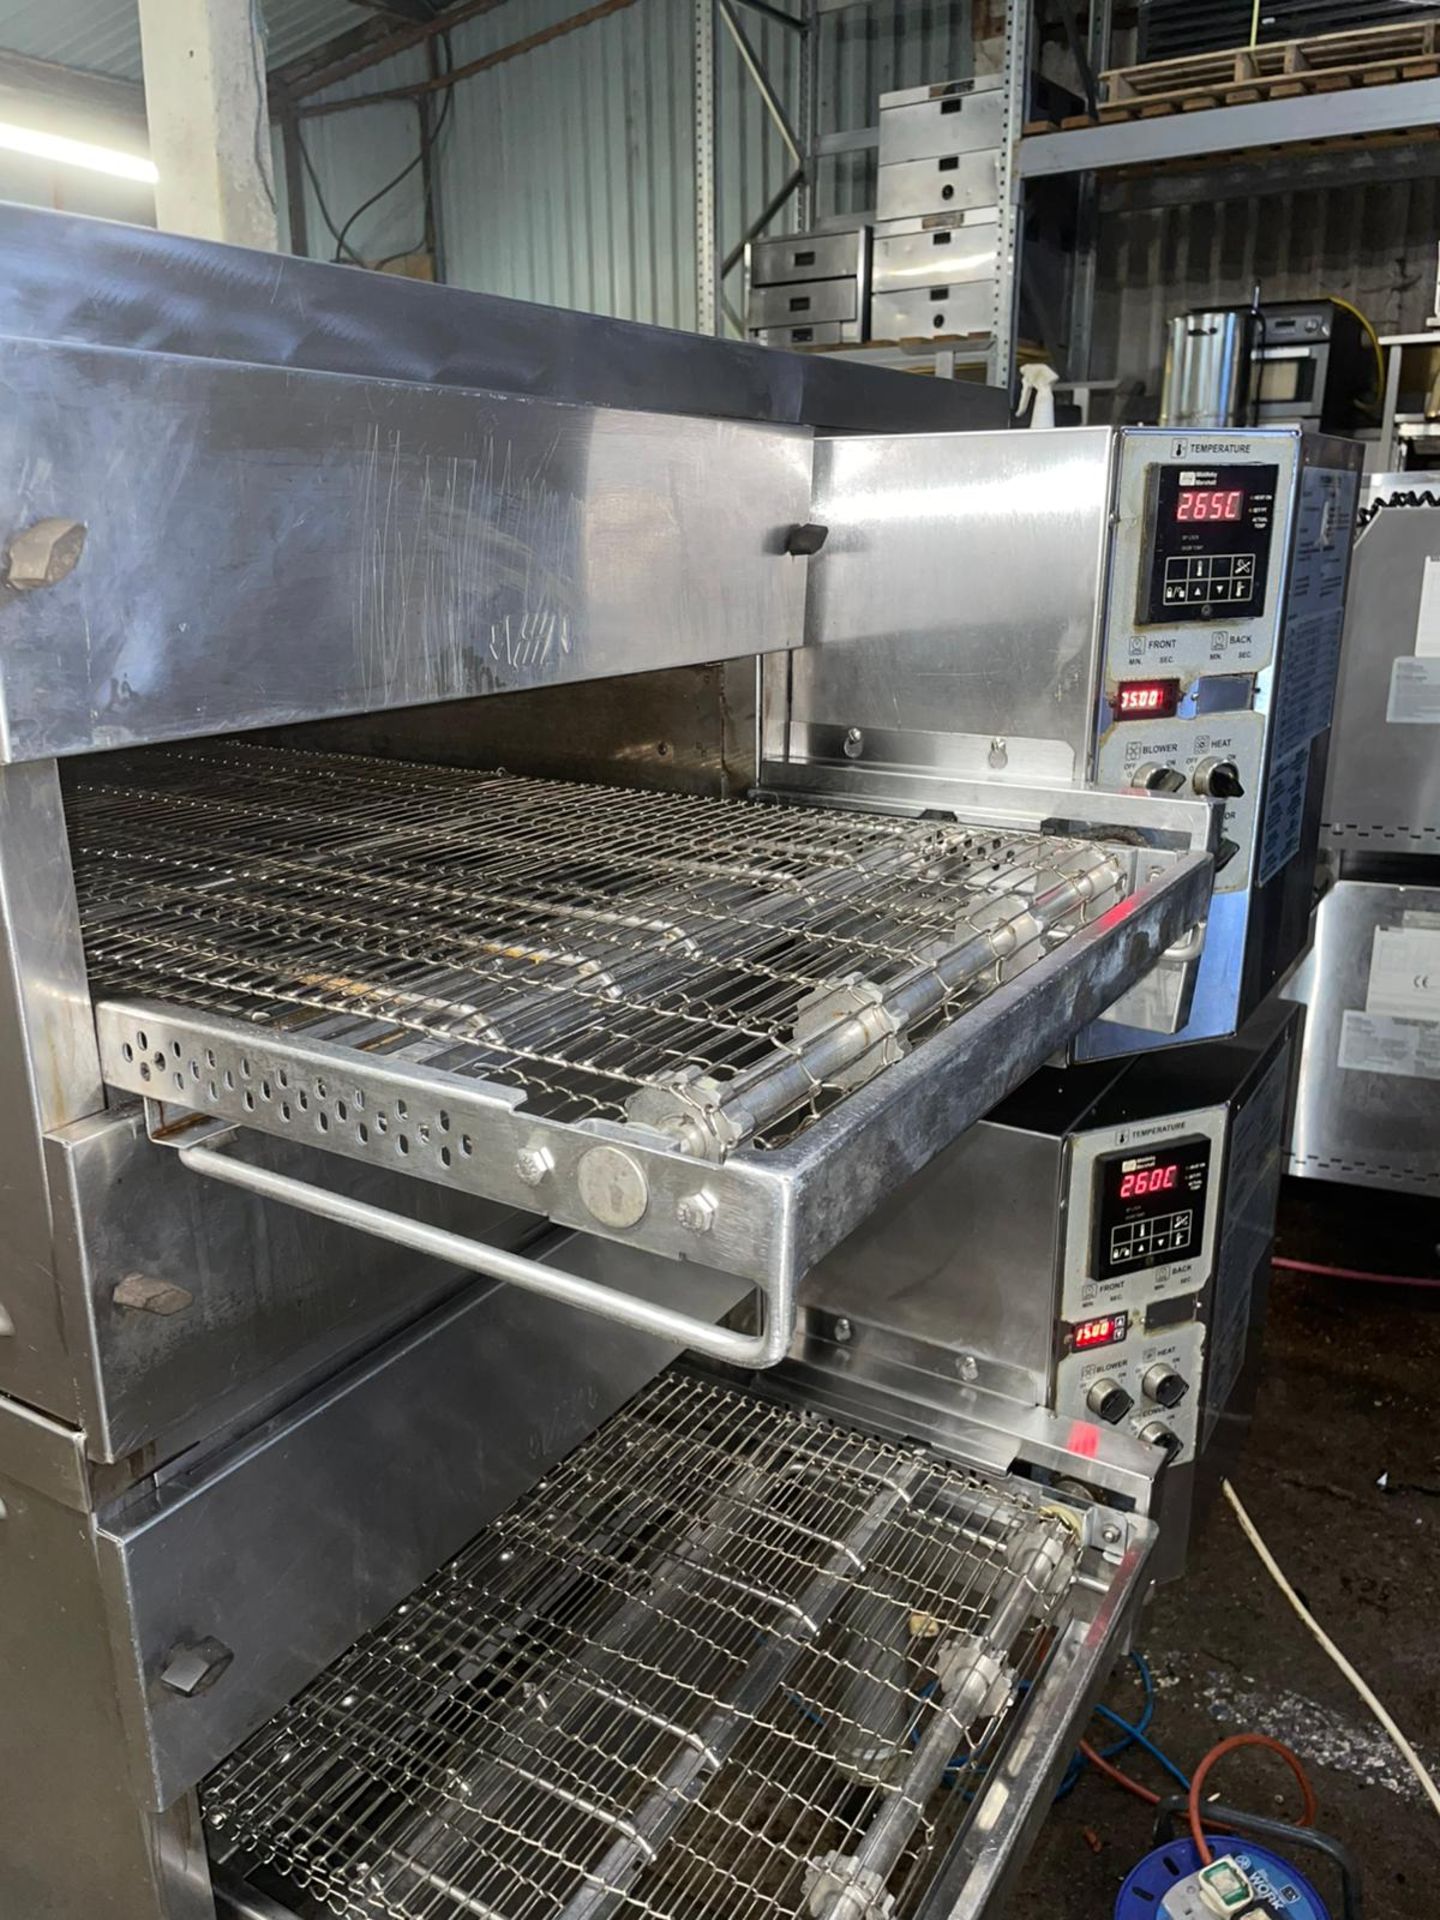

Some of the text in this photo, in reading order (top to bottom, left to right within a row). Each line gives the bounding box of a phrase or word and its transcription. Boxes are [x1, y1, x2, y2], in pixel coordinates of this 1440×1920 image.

[1190, 444, 1251, 454] TEMPERATURE
[1148, 639, 1177, 649] FRONT
[1229, 635, 1252, 645] BACK
[1142, 743, 1178, 755] BLOWER
[1211, 739, 1232, 749] HEAT
[1132, 1122, 1185, 1138] TEMPERATURE
[1172, 1265, 1192, 1275] BACK
[1100, 1281, 1125, 1292] FRONT
[1157, 1346, 1176, 1356] HEAT
[1096, 1360, 1128, 1374] BLOWER
